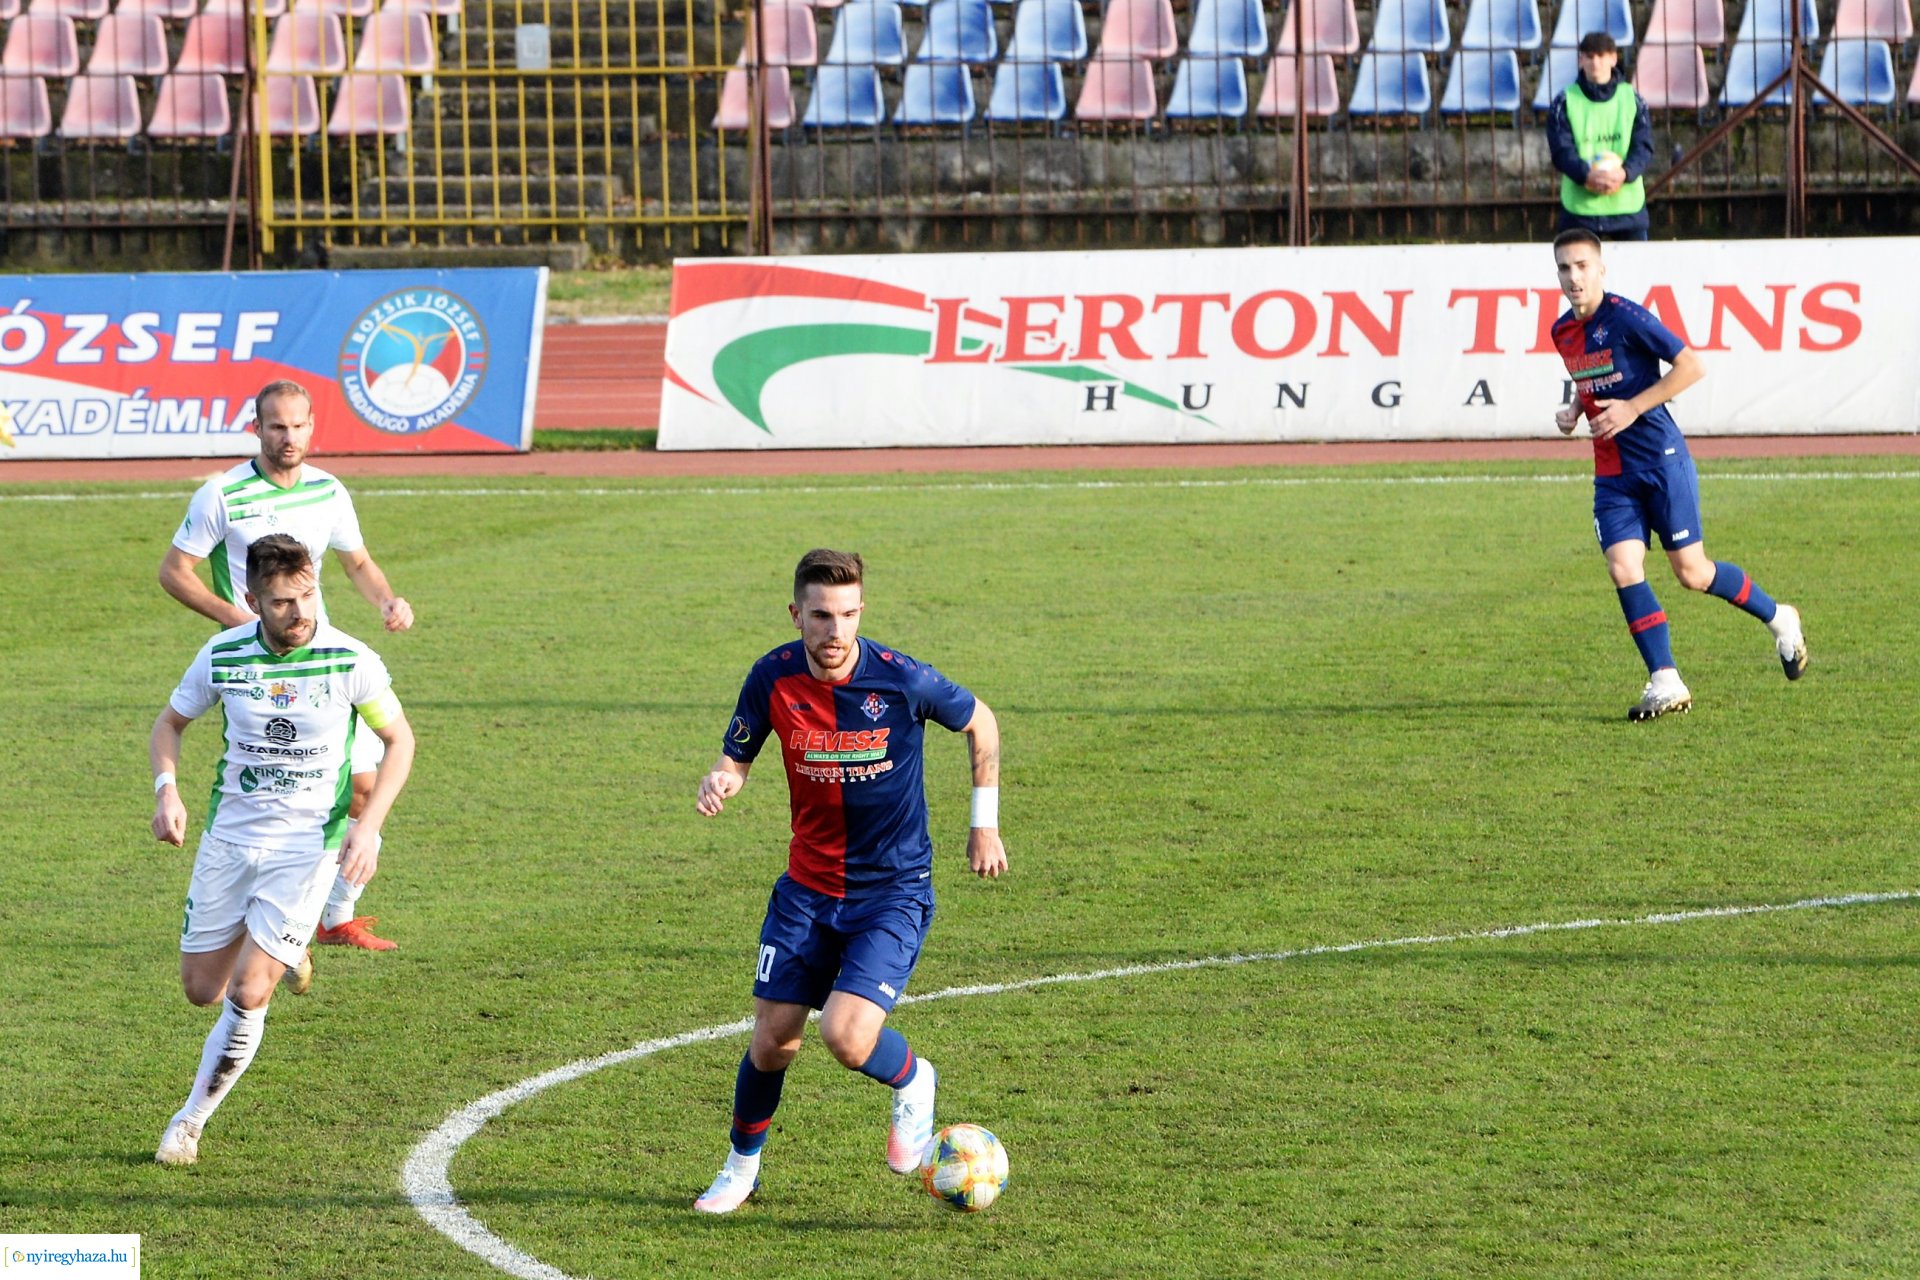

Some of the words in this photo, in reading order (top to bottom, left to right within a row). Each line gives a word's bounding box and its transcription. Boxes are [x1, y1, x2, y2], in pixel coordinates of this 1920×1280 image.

[352, 293, 416, 344] BOZSIK
[923, 292, 1415, 364] LERTON
[237, 742, 329, 757] SZABADICS
[790, 727, 891, 752] REVESZ
[870, 750, 885, 758] WAY
[254, 767, 285, 780] FINO
[287, 769, 324, 780] FRISS
[846, 760, 894, 777] TRANS
[755, 943, 777, 983] 10
